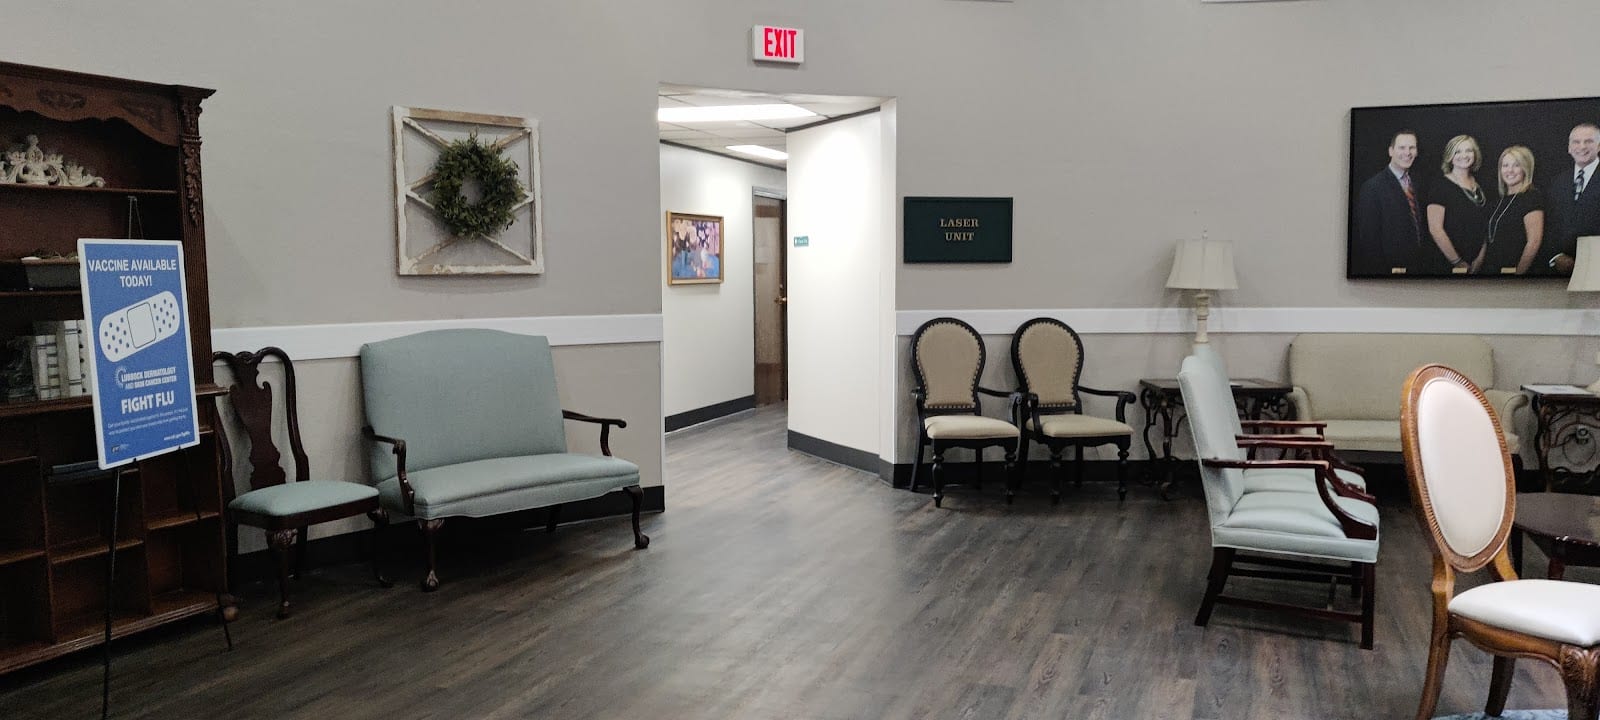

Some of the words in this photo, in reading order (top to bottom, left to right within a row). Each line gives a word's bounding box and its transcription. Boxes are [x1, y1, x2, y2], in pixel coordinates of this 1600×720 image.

[764, 27, 797, 59] EXIT
[940, 218, 979, 228] LASER
[945, 232, 975, 241] UNIT
[88, 259, 129, 272] VACCINE
[131, 259, 177, 271] AVAILABLE
[119, 275, 153, 288] TODAY!
[143, 366, 176, 378] DERMATOLOGY
[121, 394, 154, 415] FIGHT
[155, 390, 175, 408] FLU
